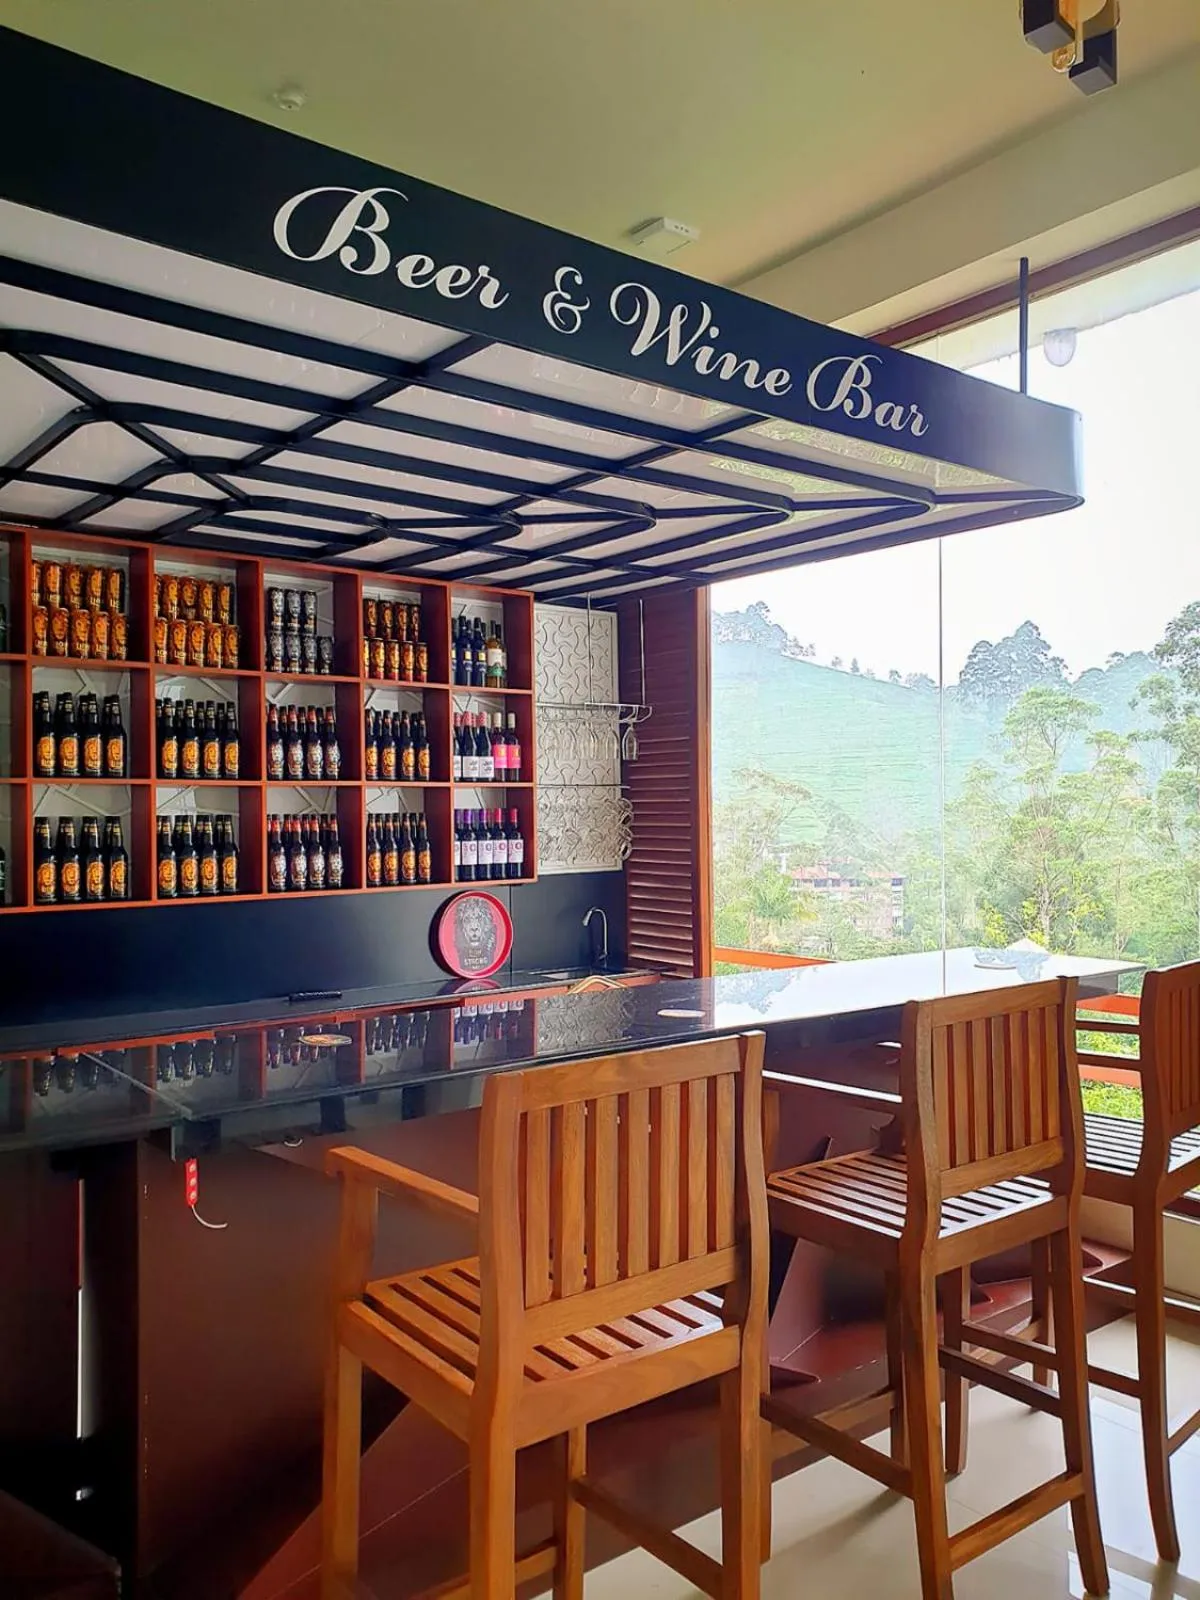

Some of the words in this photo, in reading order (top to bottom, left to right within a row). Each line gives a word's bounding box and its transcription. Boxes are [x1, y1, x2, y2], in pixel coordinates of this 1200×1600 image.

[274, 186, 510, 308] Beer
[542, 266, 591, 334] &
[609, 282, 793, 395] Wine
[806, 354, 929, 437] Bar
